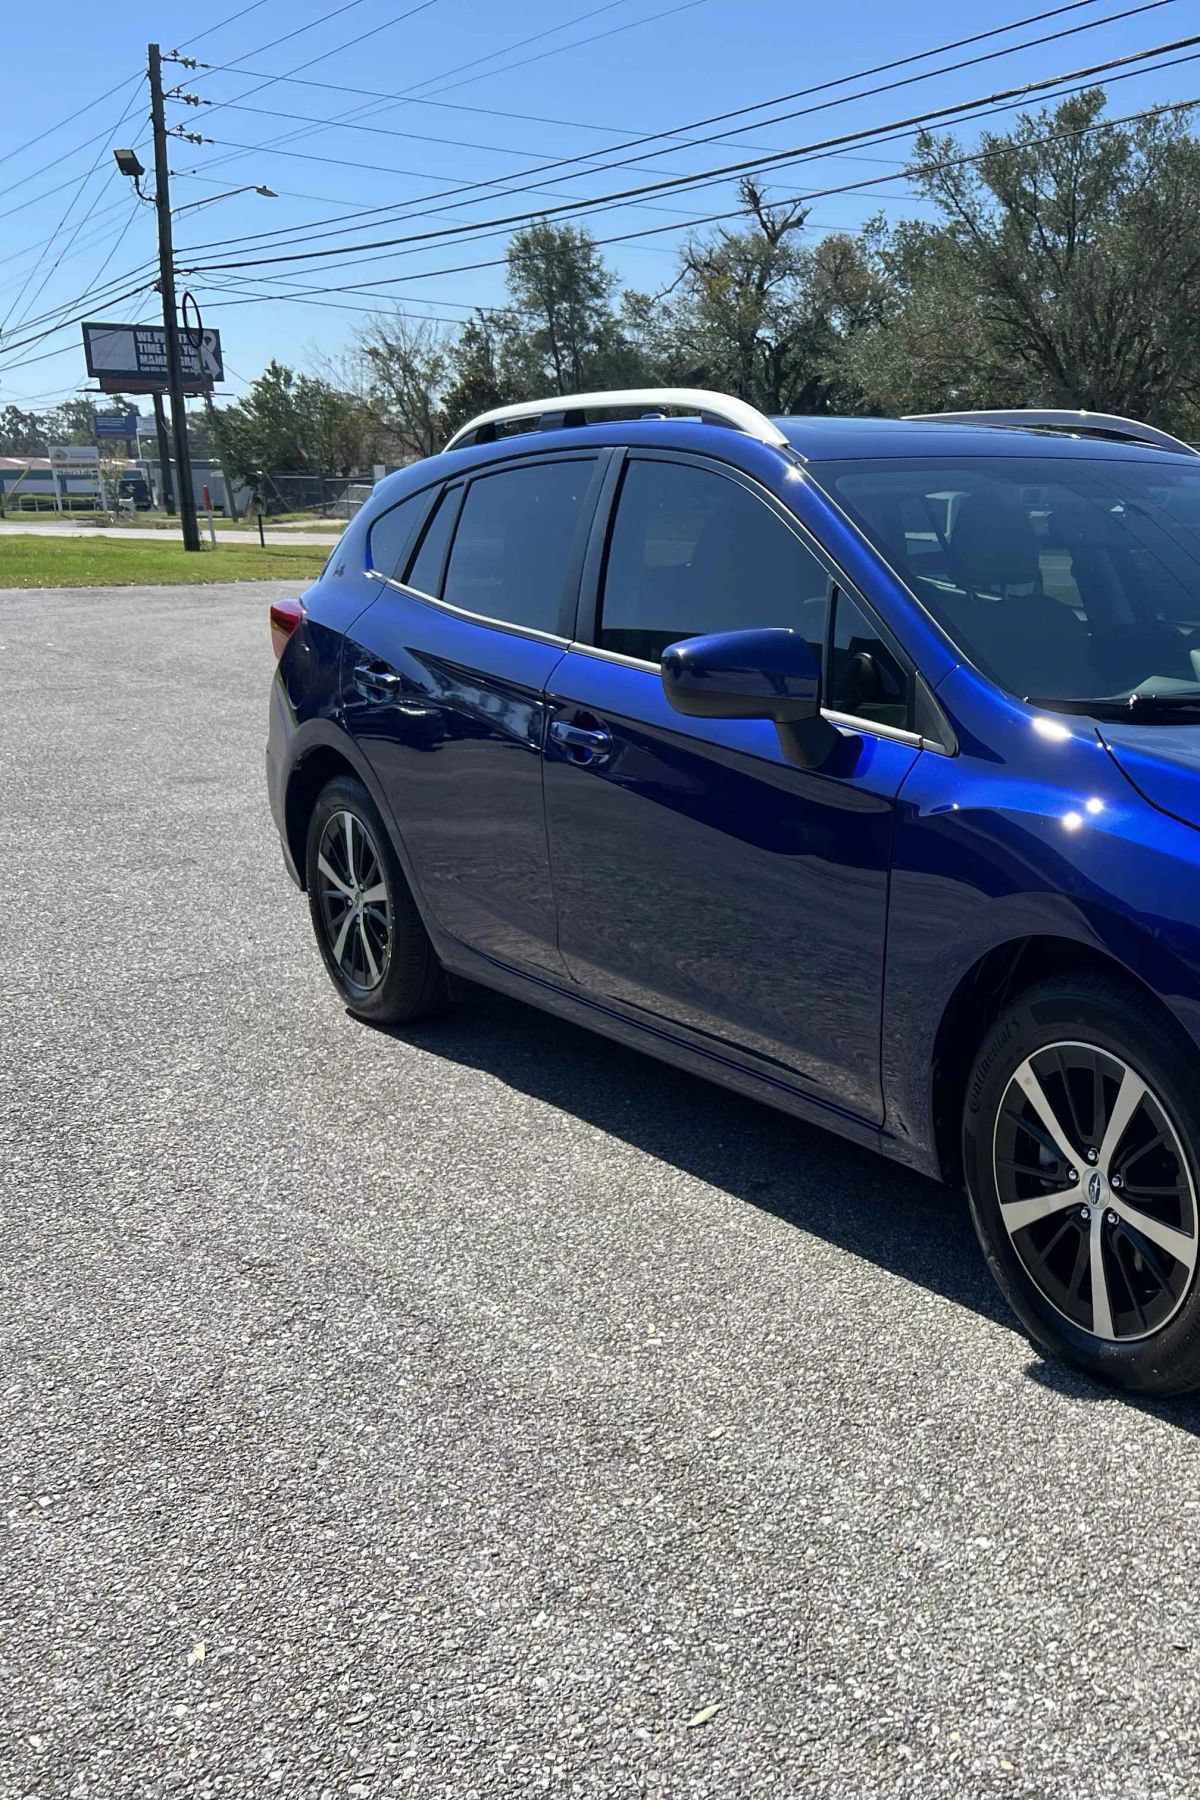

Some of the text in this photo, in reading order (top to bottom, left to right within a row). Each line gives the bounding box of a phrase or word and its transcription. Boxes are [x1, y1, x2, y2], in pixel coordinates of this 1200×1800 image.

[136, 332, 153, 342] WE
[137, 343, 162, 354] TIME
[970, 1022, 1013, 1114] Continental
